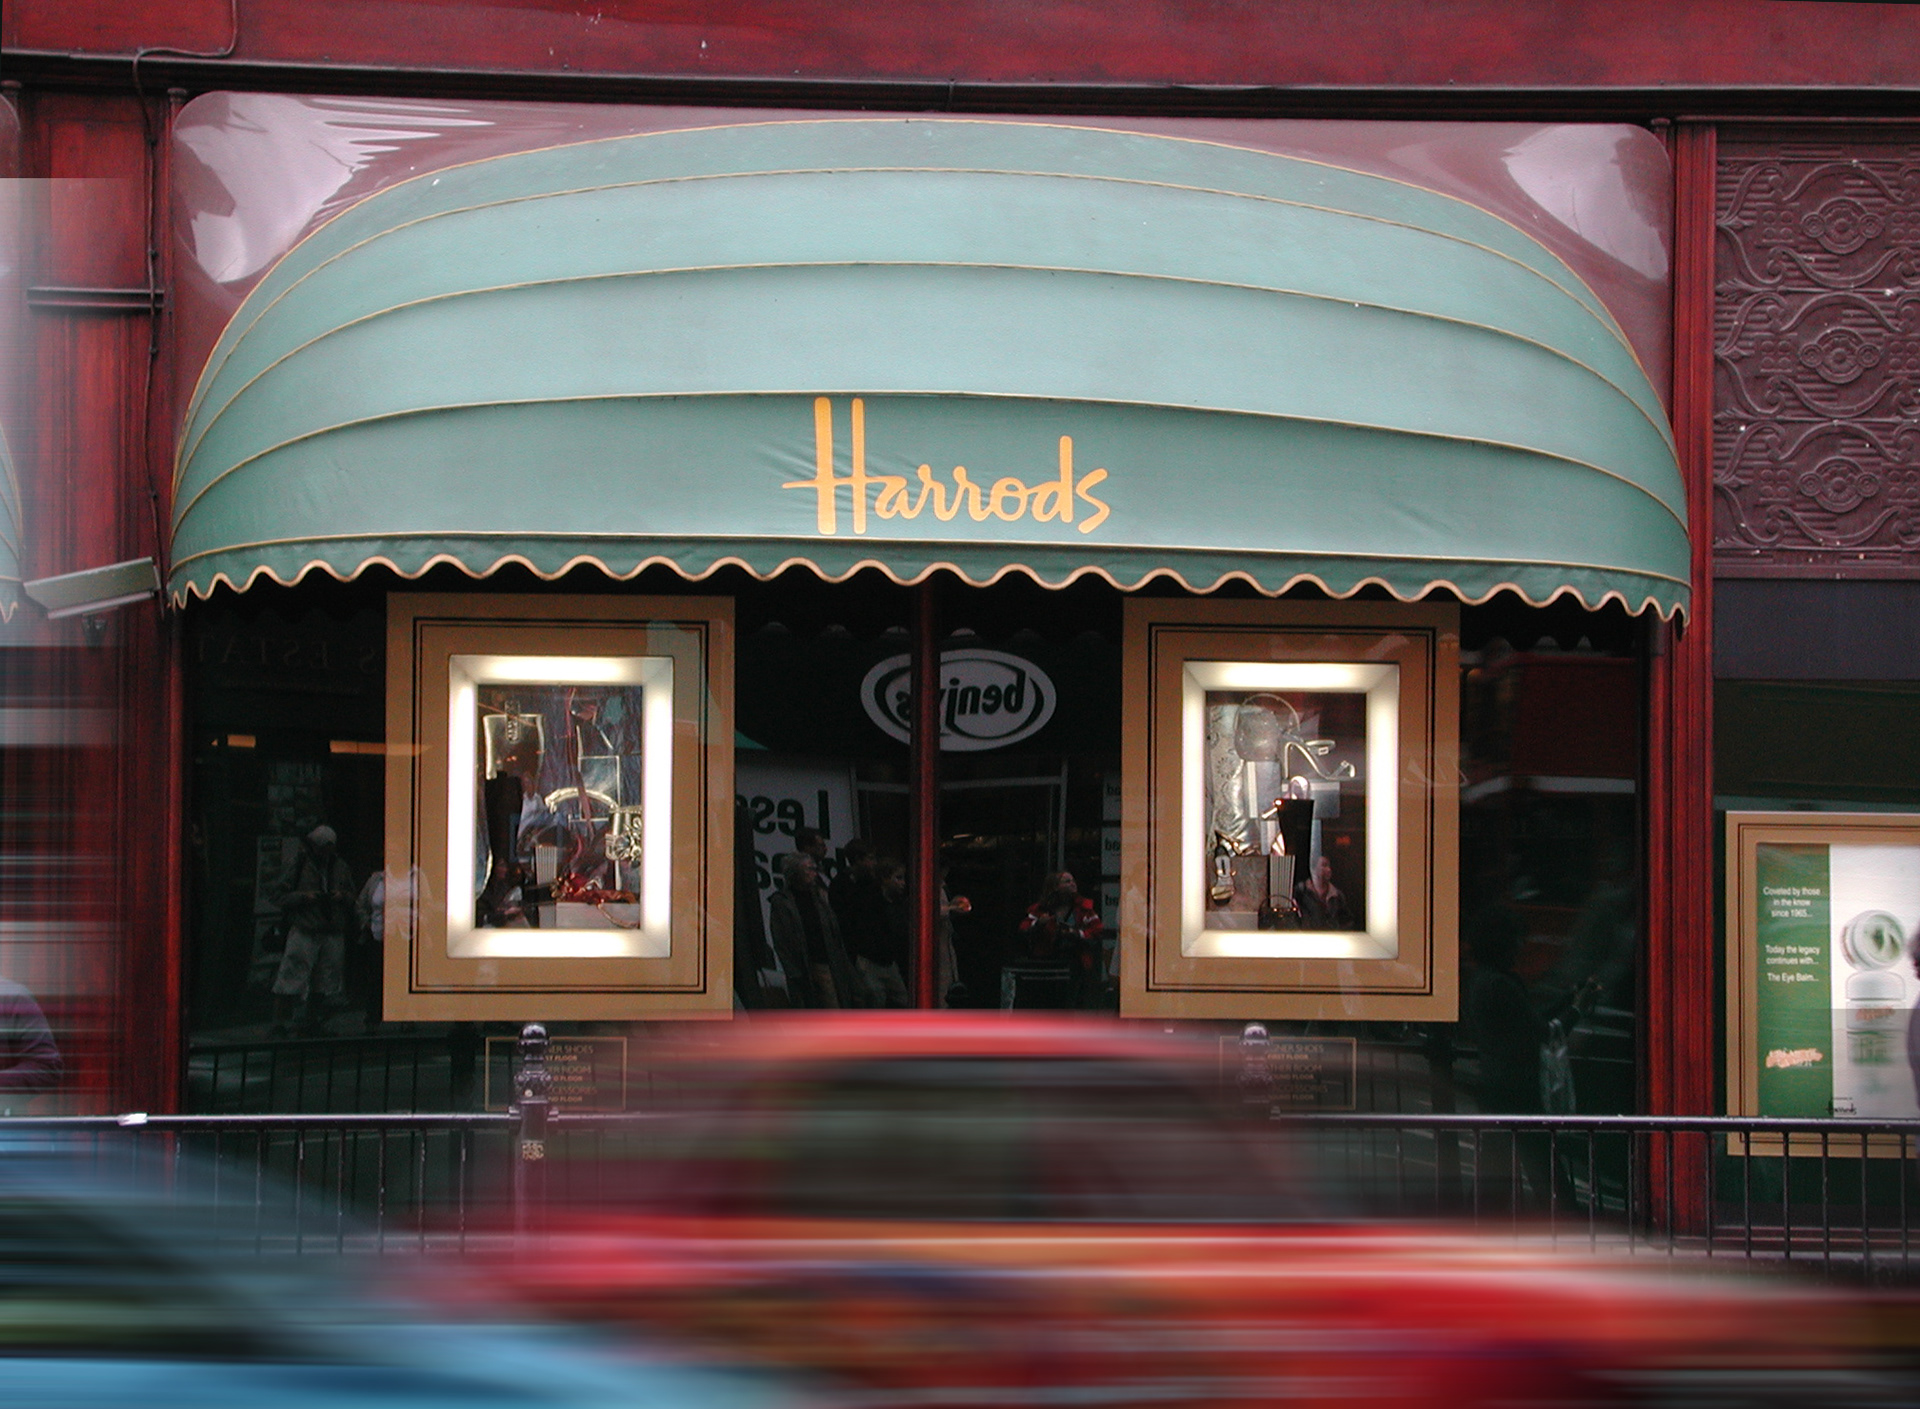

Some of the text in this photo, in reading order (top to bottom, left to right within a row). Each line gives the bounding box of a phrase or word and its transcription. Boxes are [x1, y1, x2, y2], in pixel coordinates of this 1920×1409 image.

[782, 397, 1111, 535] Harrods
[1763, 886, 1821, 897] Coveted by those
[1773, 898, 1811, 906] in the know
[1771, 909, 1789, 918] since
[1765, 944, 1820, 955] Today the legacy
[1766, 956, 1798, 965] continues
[1767, 972, 1780, 982] The
[1781, 972, 1795, 983] Eye
